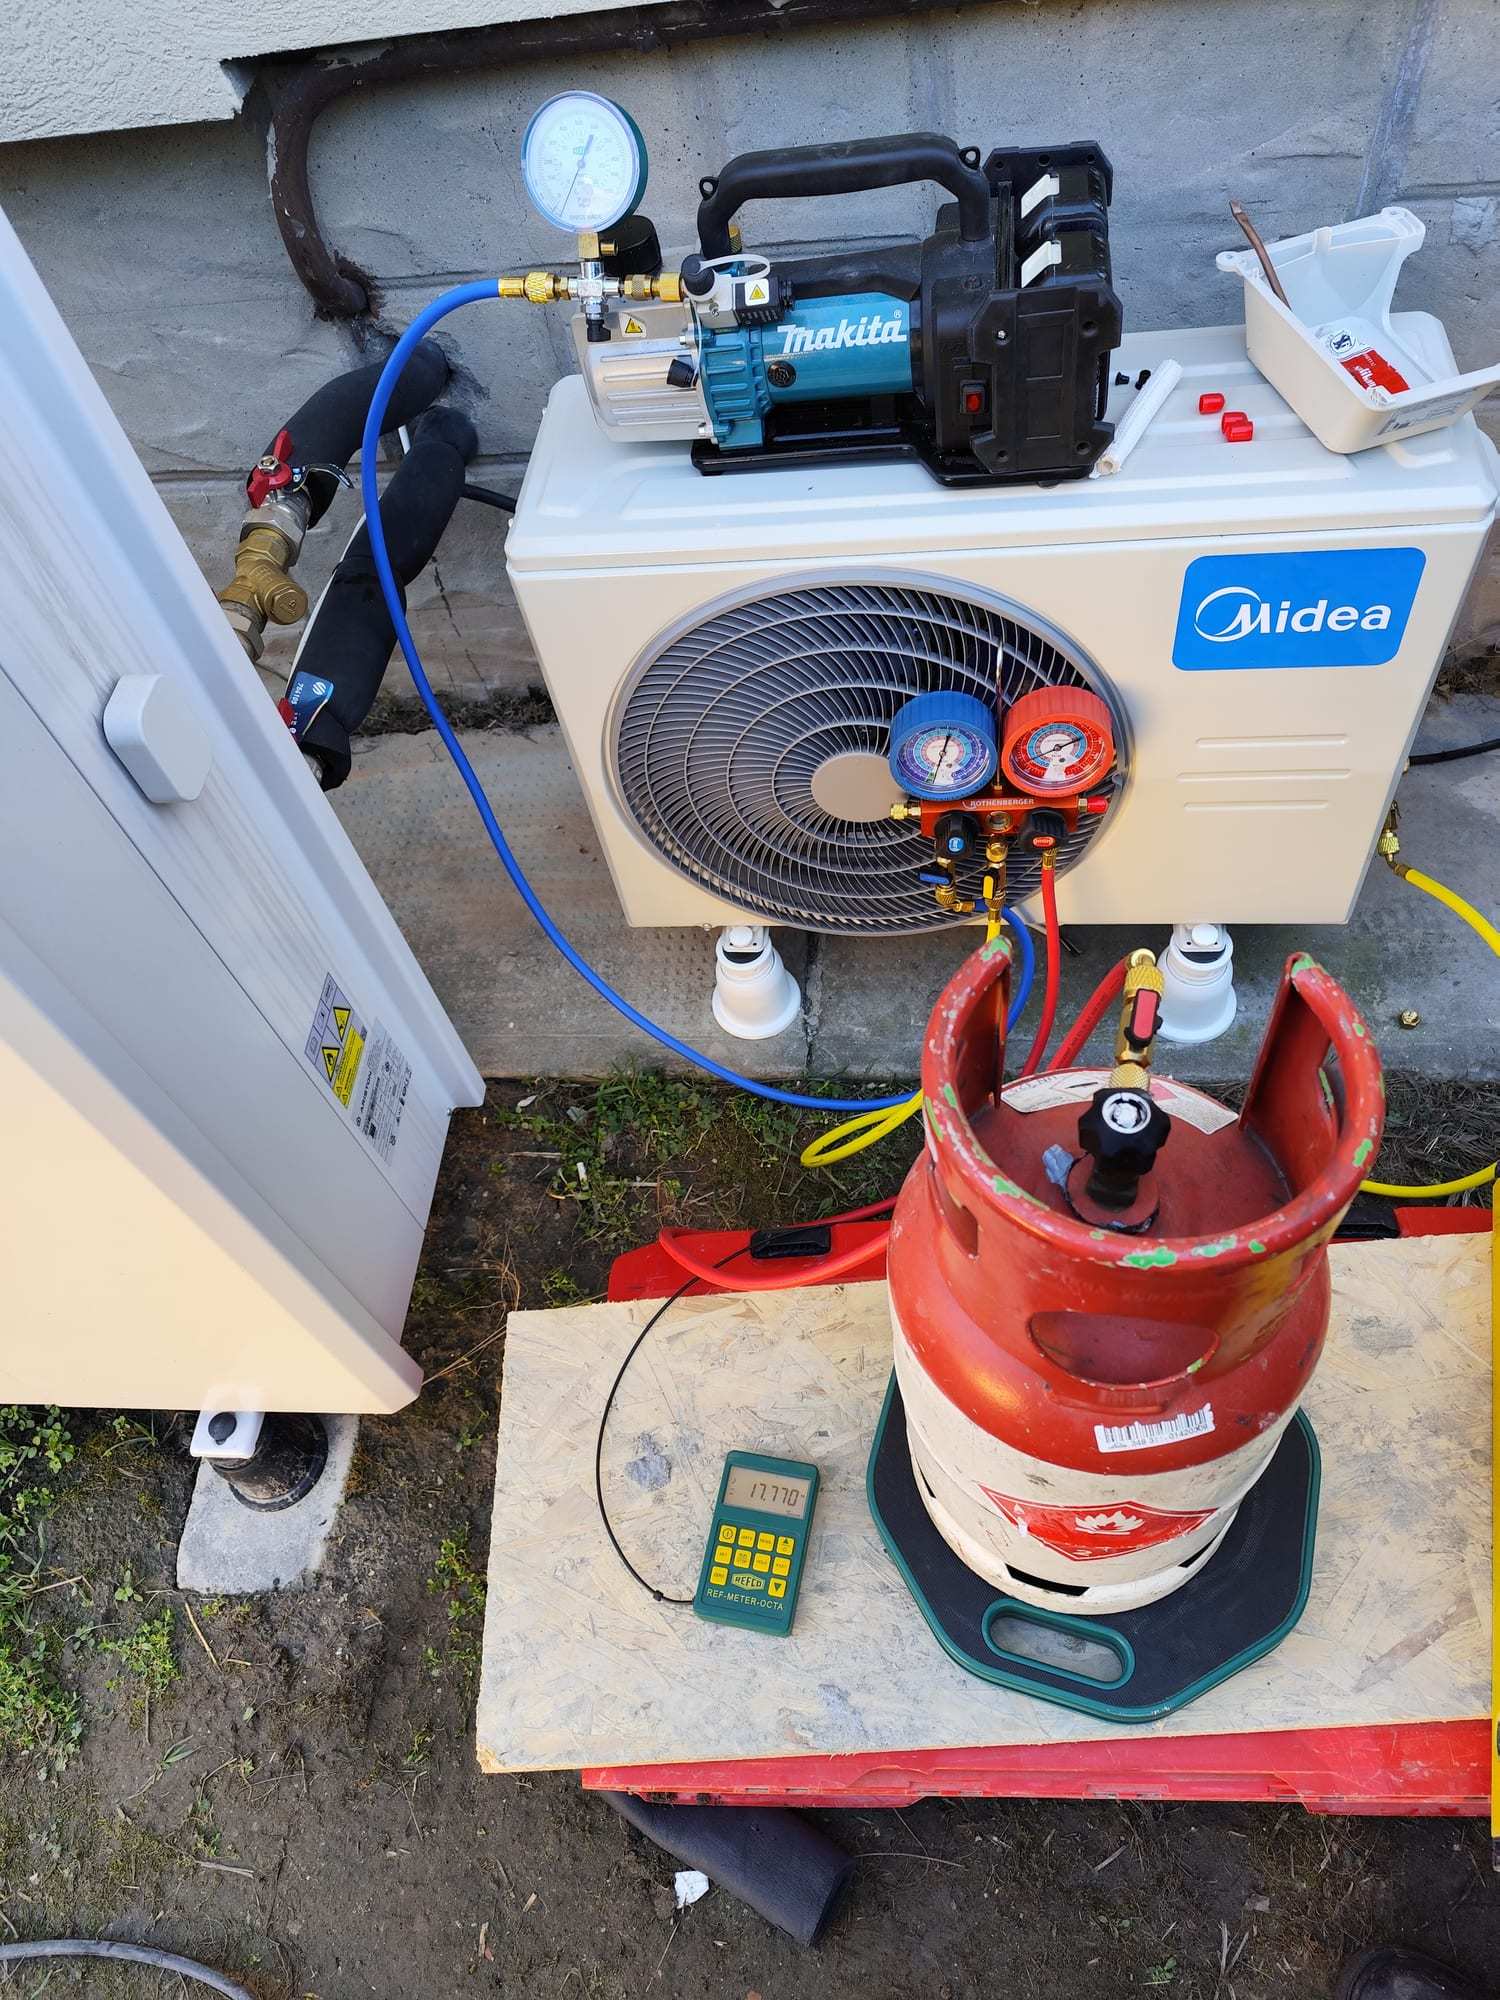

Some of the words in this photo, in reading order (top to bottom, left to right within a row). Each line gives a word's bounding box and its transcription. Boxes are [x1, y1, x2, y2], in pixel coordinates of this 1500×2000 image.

[1207, 592, 1391, 638] Midea
[970, 798, 1034, 809] ROTHENBERGER
[750, 1483, 799, 1506] 17.770
[735, 1576, 762, 1588] REFCO
